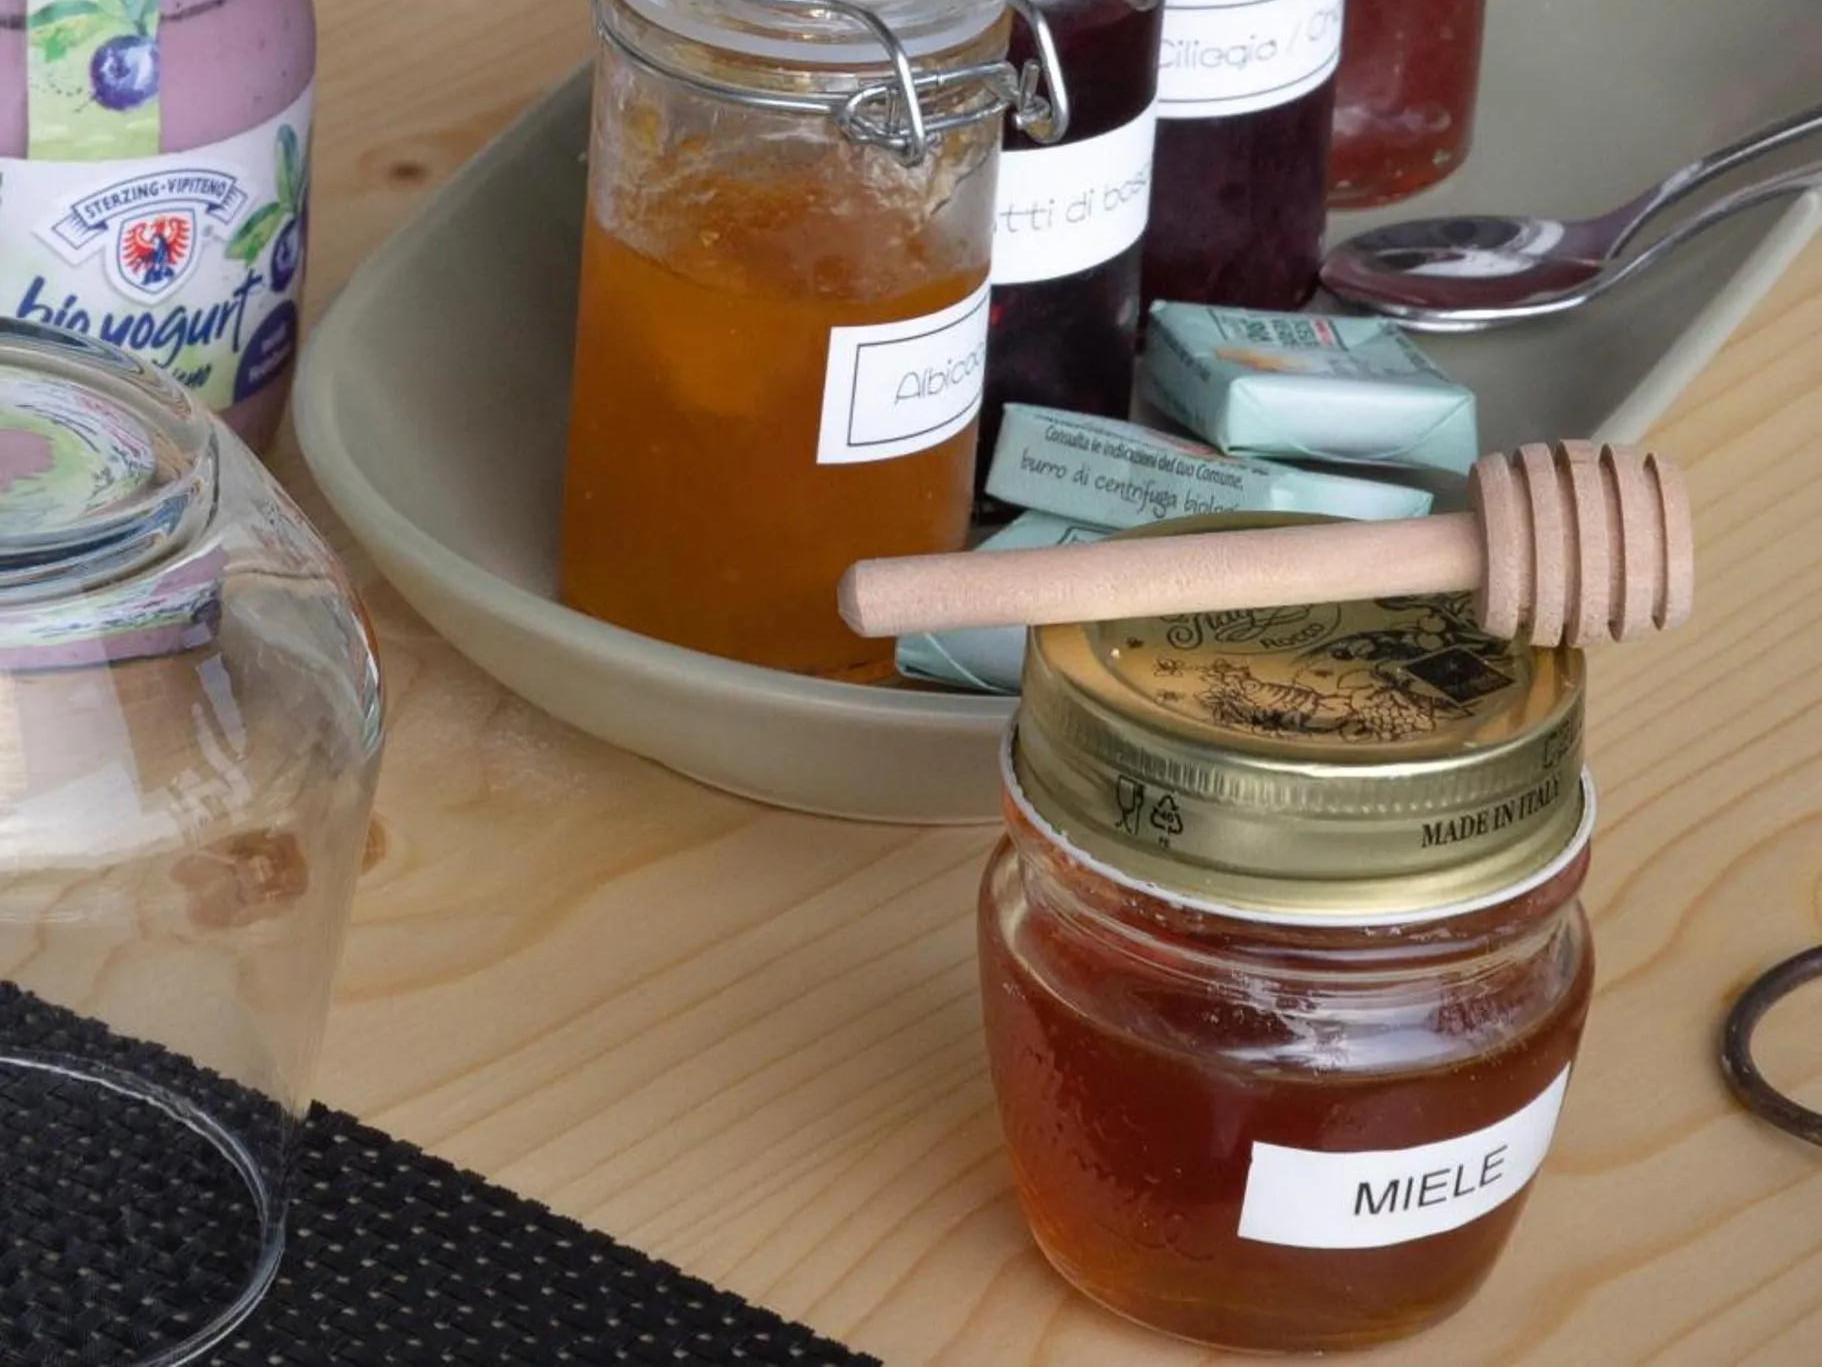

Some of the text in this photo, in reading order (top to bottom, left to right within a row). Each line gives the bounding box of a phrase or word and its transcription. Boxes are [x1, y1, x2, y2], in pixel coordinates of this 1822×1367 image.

[1065, 189, 1094, 223] di
[100, 269, 264, 368] yogurt
[1020, 449, 1067, 479] burro
[1073, 463, 1089, 486] di
[1094, 474, 1178, 519] centrifuga
[1421, 772, 1561, 848] MADE IN ITALY
[1354, 1144, 1509, 1216] MIELE
